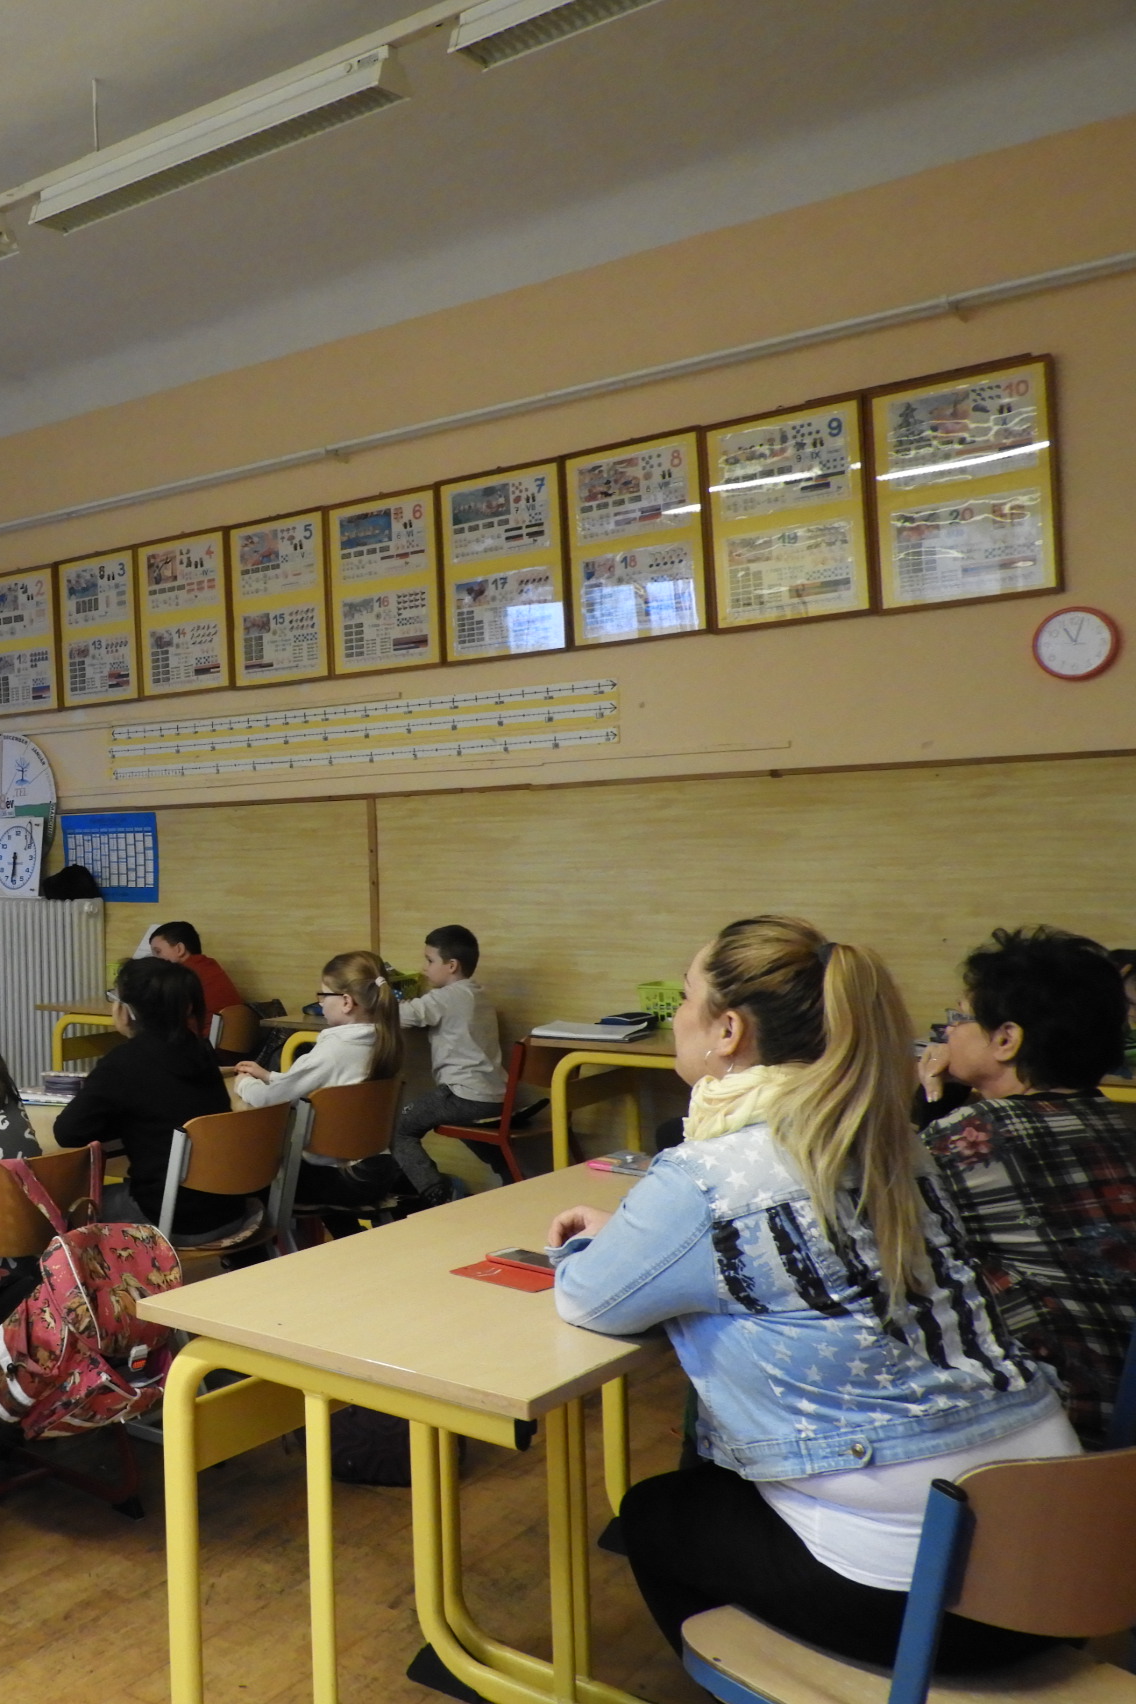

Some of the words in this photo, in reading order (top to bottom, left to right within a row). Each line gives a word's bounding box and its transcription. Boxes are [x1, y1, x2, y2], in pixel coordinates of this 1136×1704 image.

[1003, 379, 1029, 397] 10
[827, 417, 843, 437] 9
[670, 449, 683, 468] 8
[534, 477, 546, 493] 7
[412, 504, 423, 520] 6
[303, 523, 313, 540] 5
[205, 544, 214, 560] 4
[117, 562, 126, 577] 3
[621, 555, 638, 570] 18
[35, 580, 45, 598] 2
[491, 577, 509, 591] 17
[376, 596, 390, 608] 16
[272, 613, 285, 626] 15
[175, 627, 187, 639] 14
[92, 639, 103, 650] 13
[17, 653, 28, 664] 12
